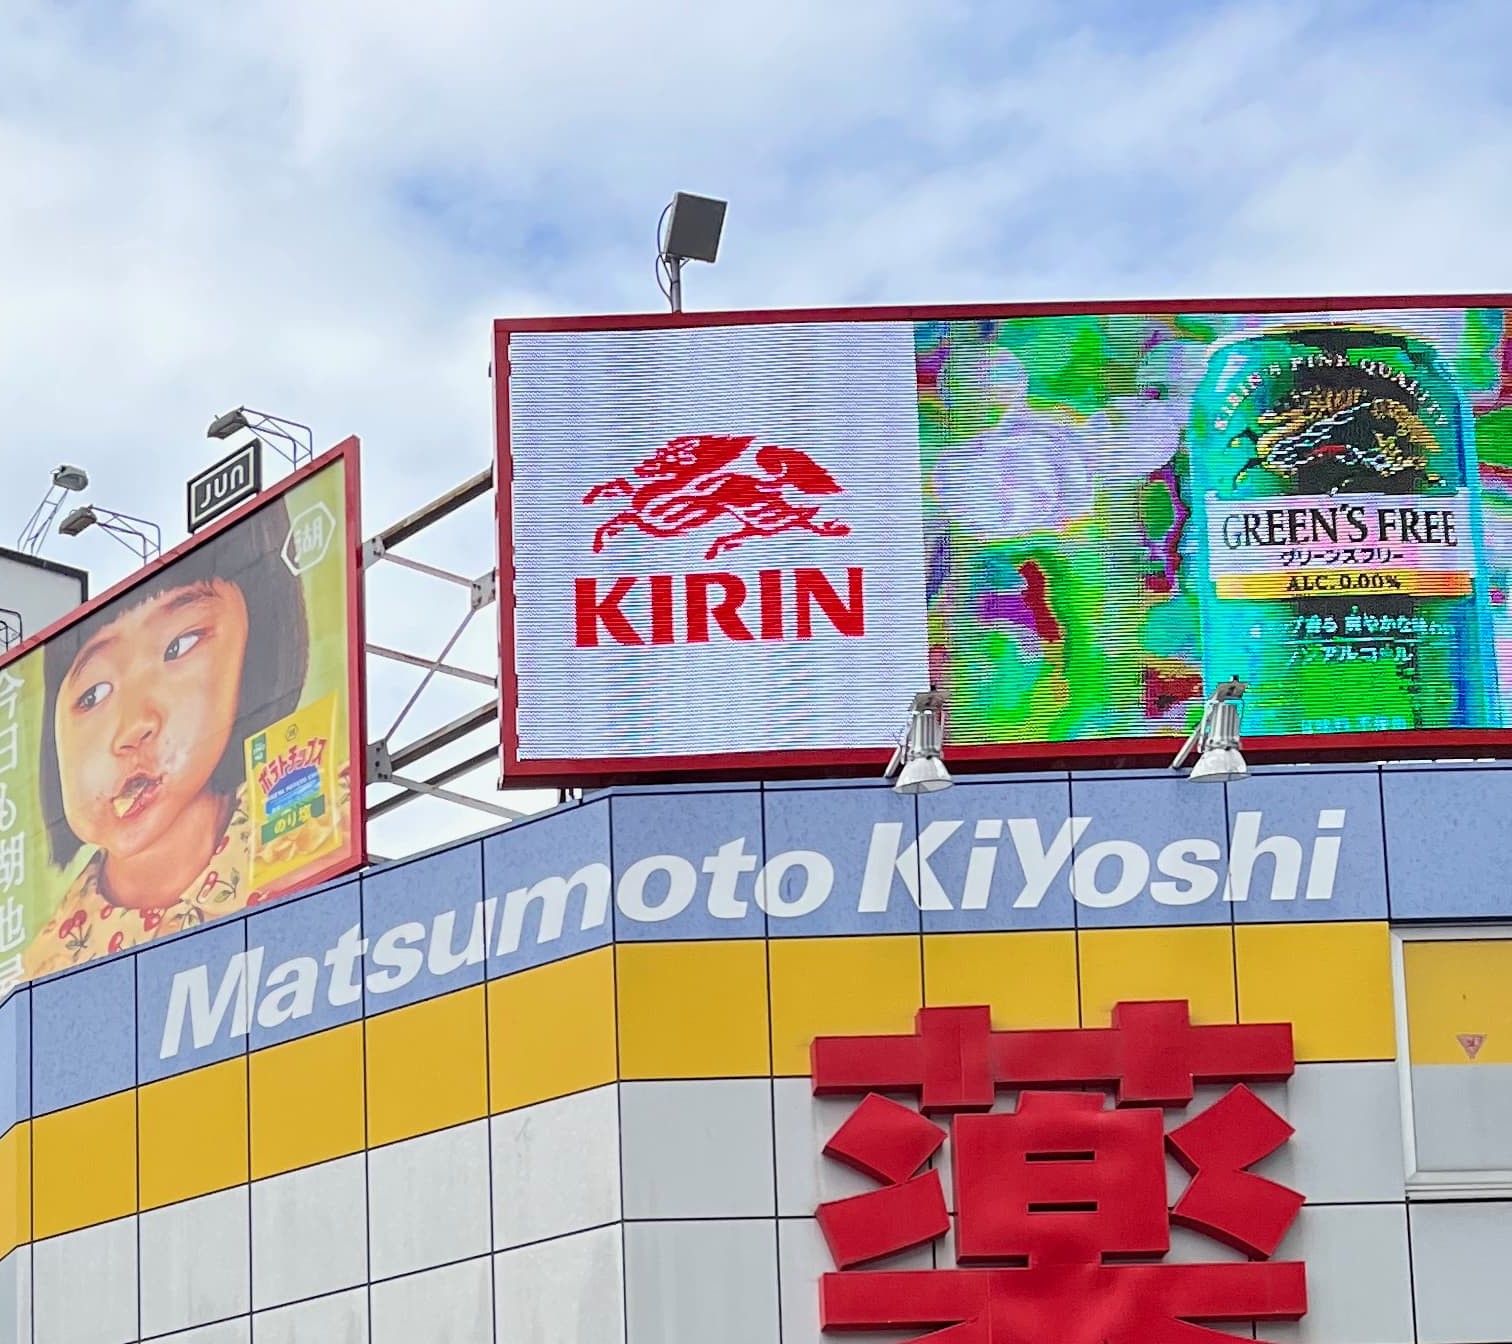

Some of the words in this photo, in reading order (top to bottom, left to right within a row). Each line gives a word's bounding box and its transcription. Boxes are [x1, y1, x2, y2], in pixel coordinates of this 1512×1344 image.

[1223, 504, 1368, 549] GREEN'S
[1379, 508, 1458, 547] FREE
[575, 567, 865, 648] KIRIN
[159, 838, 835, 1060] Matsumoto
[858, 808, 1345, 914] KiYoshi
